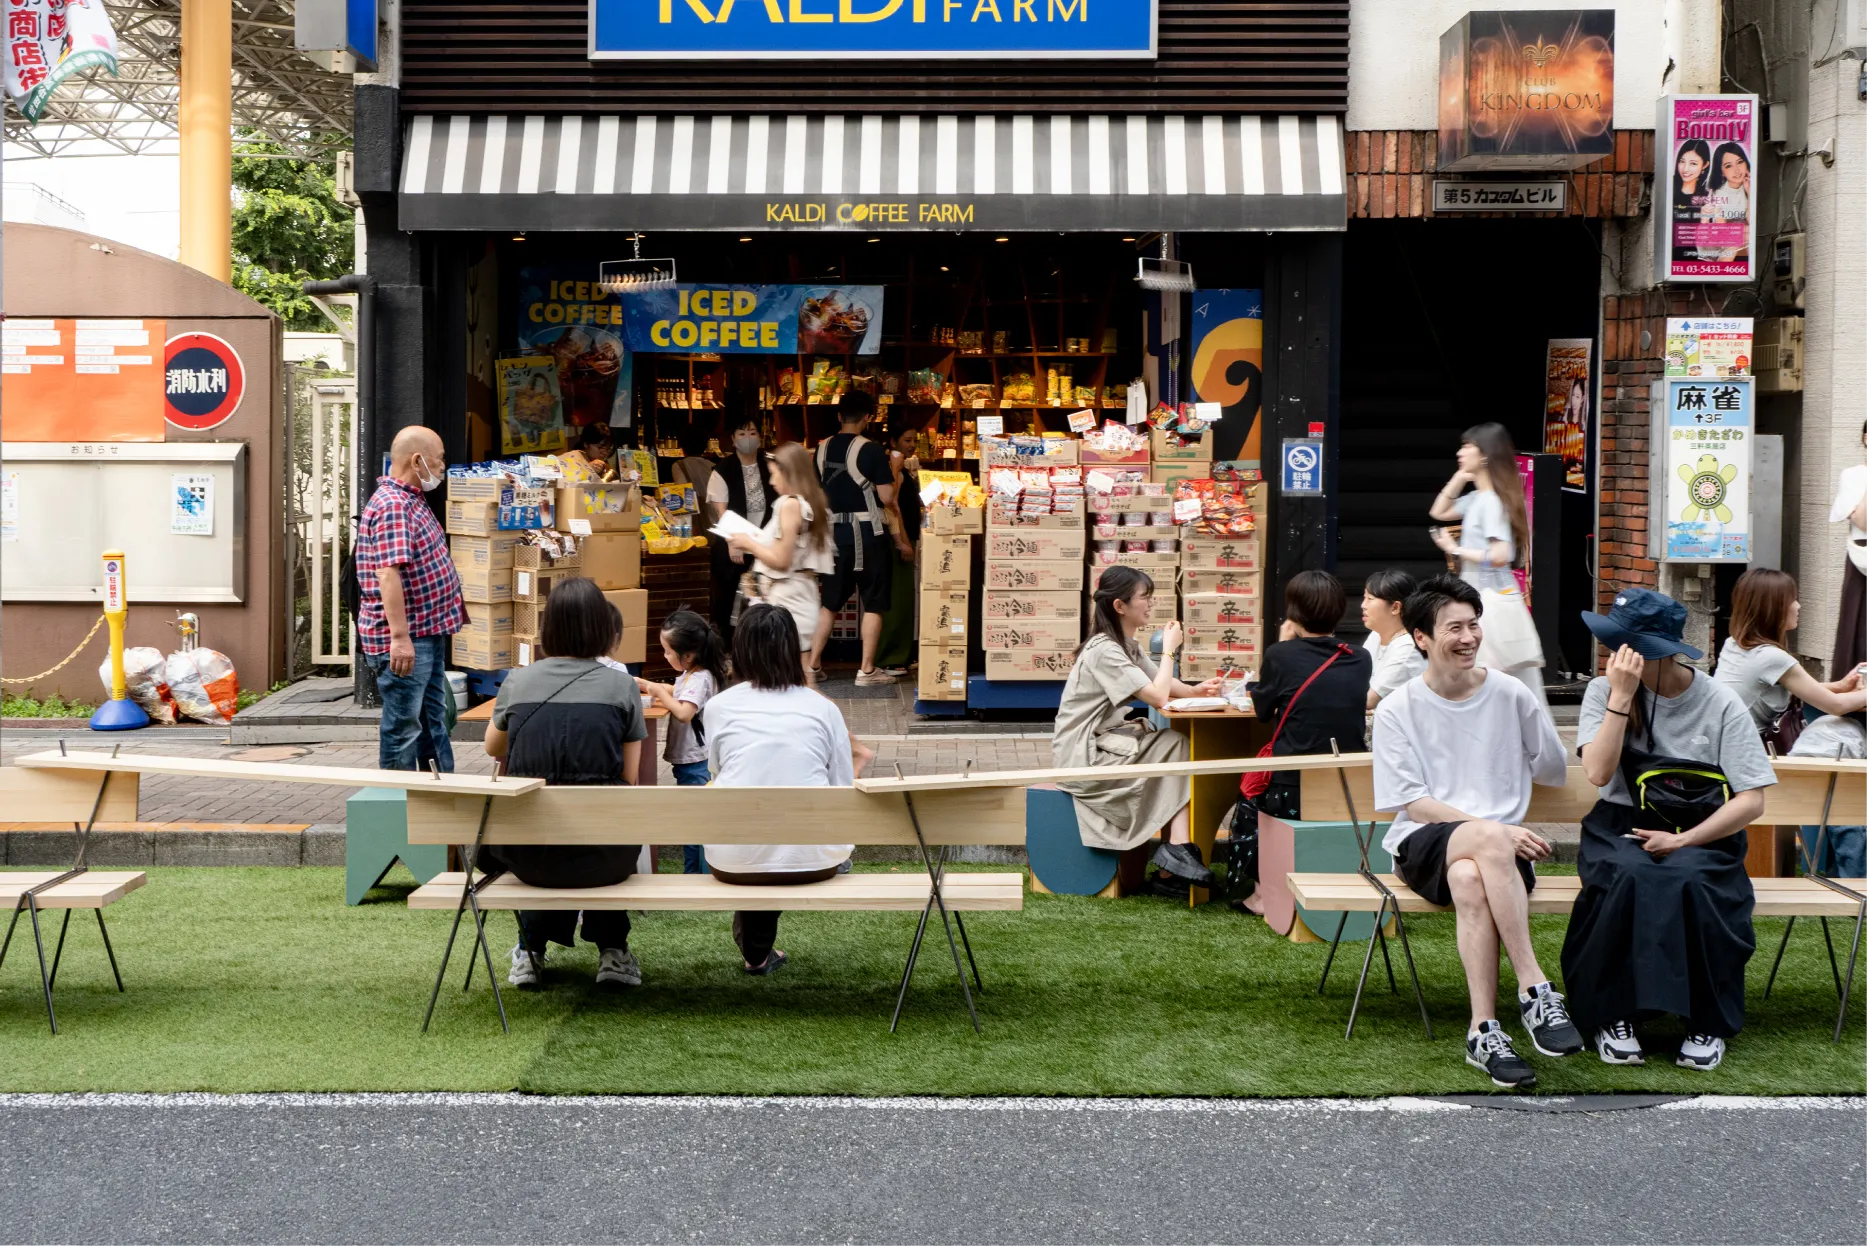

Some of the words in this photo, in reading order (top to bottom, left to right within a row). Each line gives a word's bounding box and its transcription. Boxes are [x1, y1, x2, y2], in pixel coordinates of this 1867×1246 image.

[1525, 77, 1556, 87] CLUB
[1479, 92, 1602, 110] KINGDOM
[1738, 104, 1748, 114] 3F
[1691, 109, 1716, 119] girl's
[1718, 108, 1735, 118] bar
[1675, 117, 1749, 143] Bounty
[1443, 187, 1557, 204] 第5カスタムビル
[766, 203, 826, 222] KALDI
[837, 203, 909, 222] COFFEE
[919, 203, 974, 222] FARM
[1686, 265, 1746, 273] 03-5433-4666
[550, 280, 608, 302] ICED
[678, 289, 757, 316] ICED
[528, 303, 623, 325] COFFEE
[650, 320, 779, 348] COFFEE
[166, 368, 227, 394] 消防水利
[1676, 385, 1742, 411] 麻雀
[1705, 413, 1723, 423] 3F
[1672, 428, 1744, 441] かめきたざわ
[70, 444, 118, 455] お知らせ
[1292, 481, 1312, 490] 禁止
